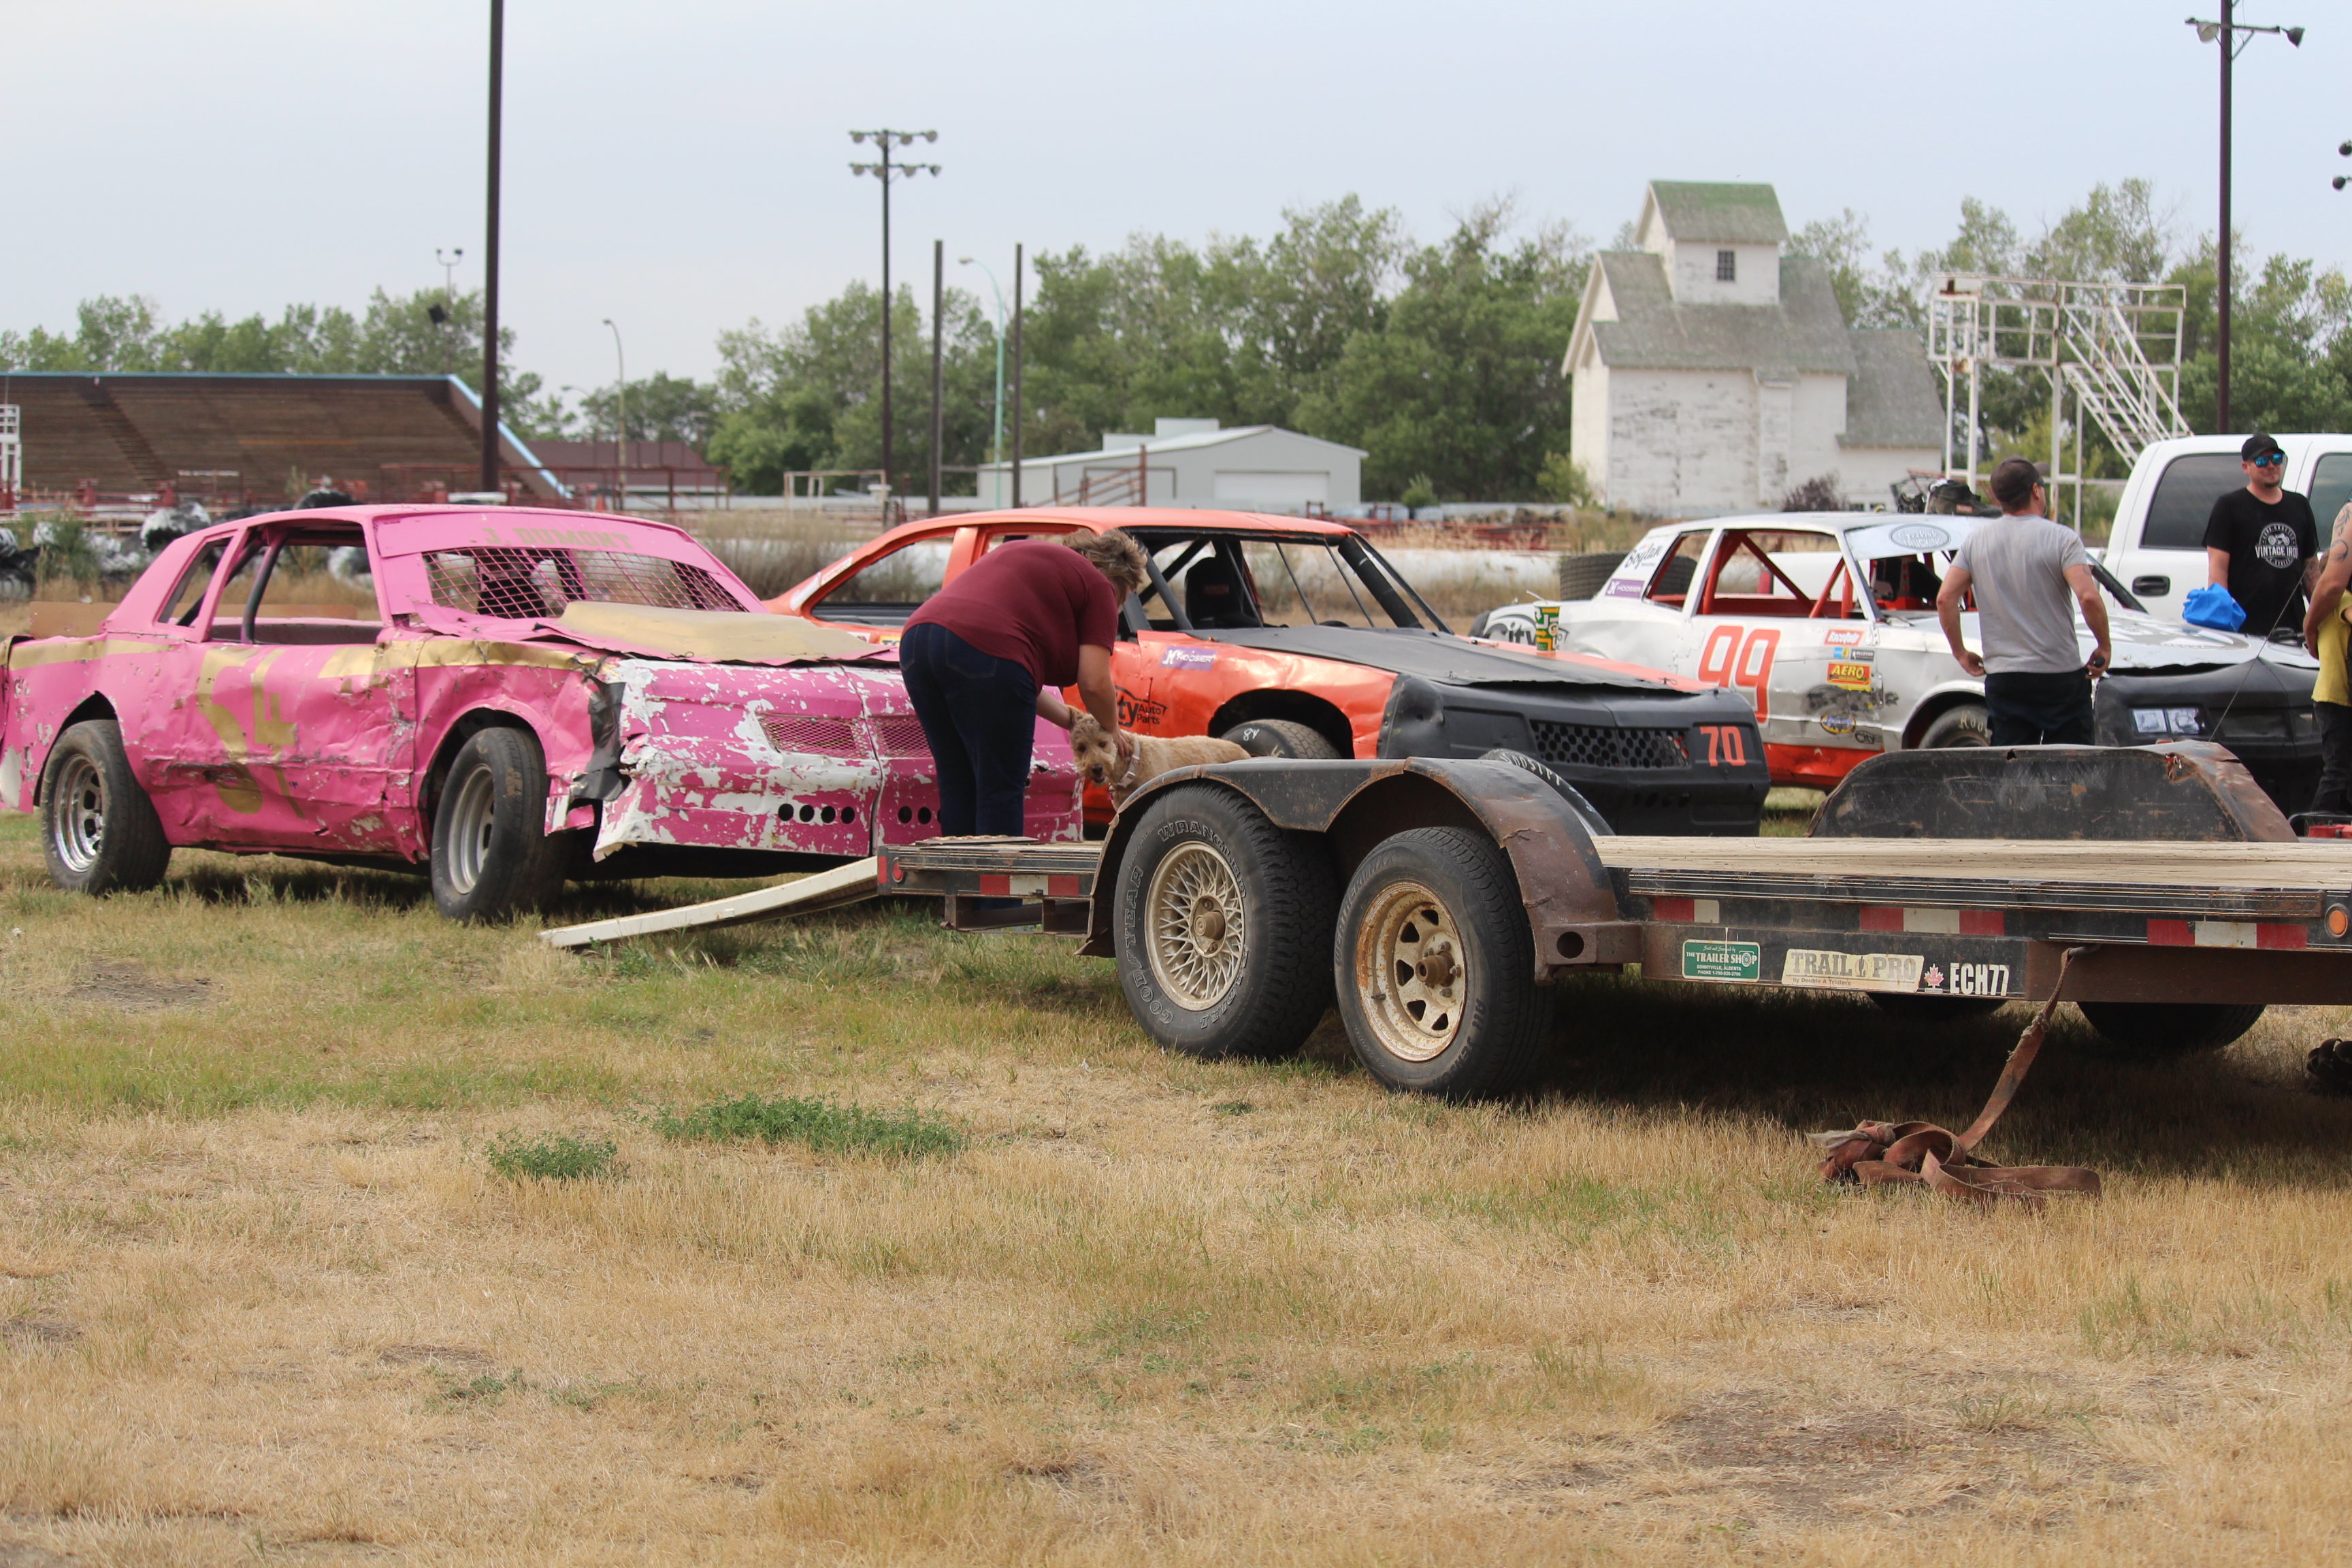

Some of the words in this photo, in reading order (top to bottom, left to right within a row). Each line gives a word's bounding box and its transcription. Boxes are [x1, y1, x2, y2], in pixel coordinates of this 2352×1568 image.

[482, 528, 510, 544] J.
[512, 528, 634, 549] DUMONT
[1903, 538, 1944, 548] TRUCKING
[2255, 545, 2286, 559] VINTAGE
[1617, 585, 1642, 593] HOOSIER
[1176, 653, 1213, 664] HOOSIER
[1698, 625, 1781, 724] 99
[1831, 665, 1864, 679] AERO
[1138, 704, 1162, 715] Auto
[1137, 714, 1160, 725] Parts
[197, 647, 305, 818] 54
[1855, 732, 1876, 745] City
[1699, 726, 1747, 767] 70
[1158, 820, 1247, 898] WRANGLER
[1124, 865, 1173, 1025] GOODYEAR
[1696, 953, 1729, 963] TRAILER
[1731, 952, 1757, 968] SHOP
[1791, 952, 1852, 977] TRAIL
[1872, 957, 1916, 980] PRO
[1950, 962, 2010, 996] ECH77
